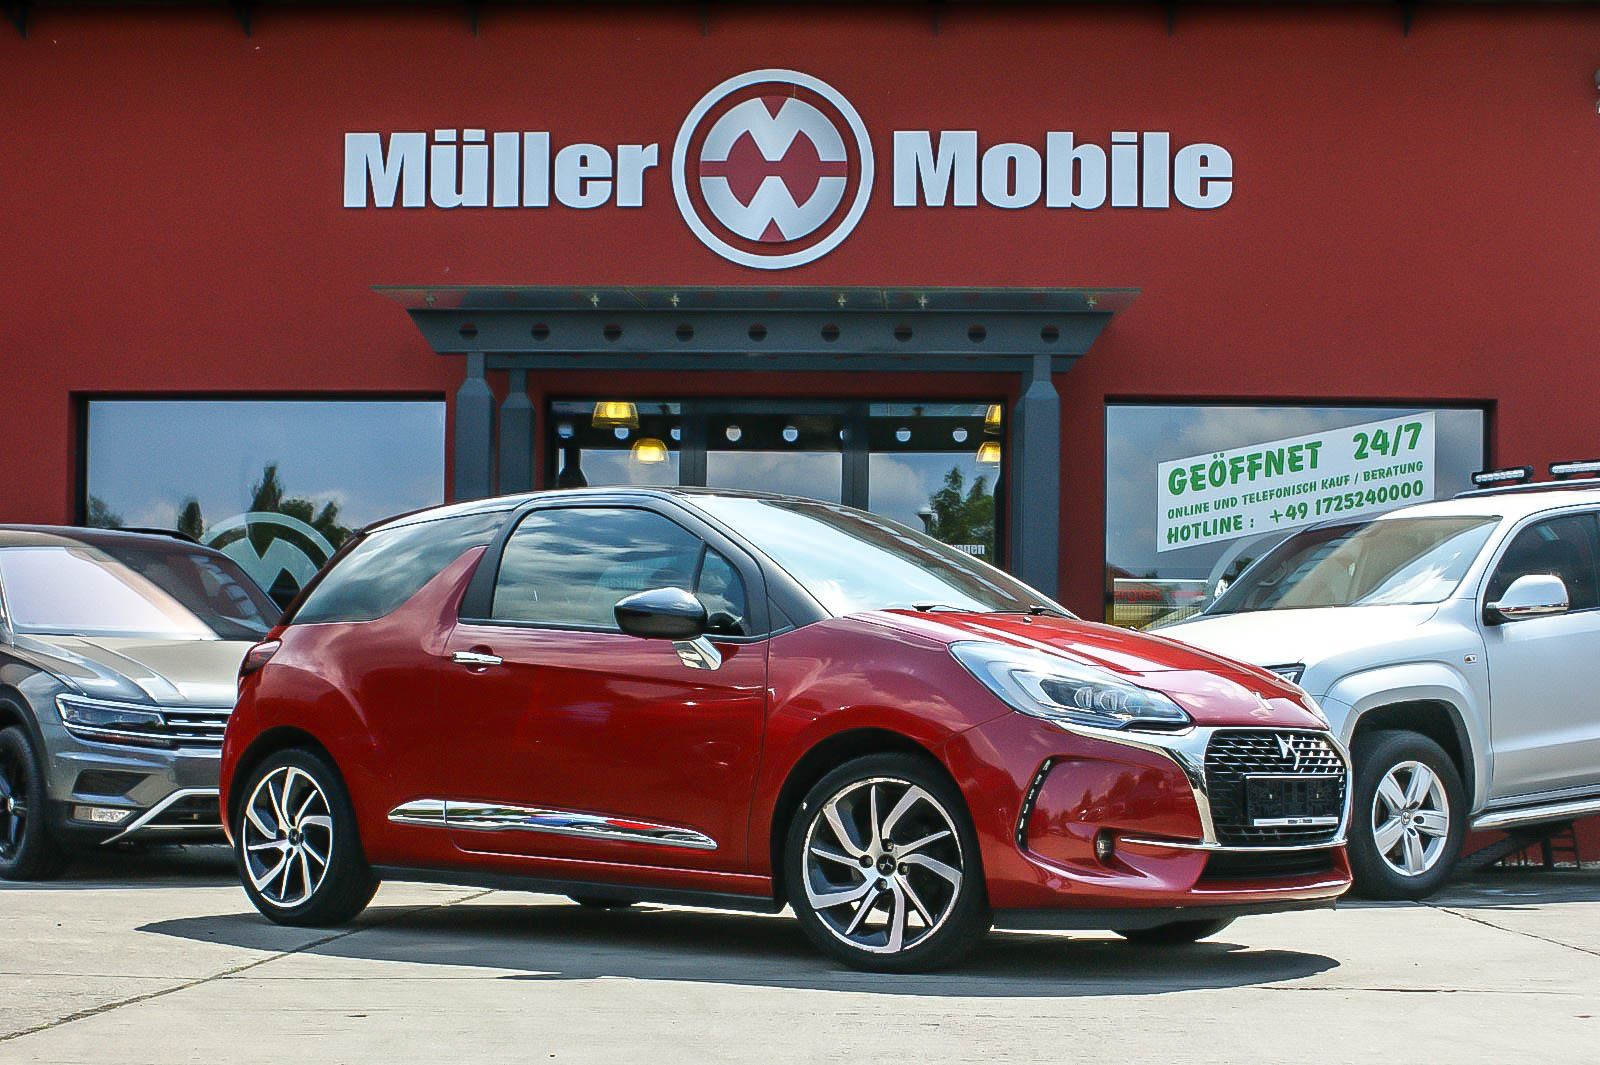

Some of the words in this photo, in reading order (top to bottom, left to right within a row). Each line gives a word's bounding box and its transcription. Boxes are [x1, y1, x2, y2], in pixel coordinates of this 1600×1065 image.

[343, 128, 659, 209] Müller
[893, 130, 1234, 210] Mobile
[1166, 440, 1323, 497] GEÖFFNET
[1351, 420, 1424, 462] 24/7
[1167, 502, 1210, 519] ONLINE
[1213, 497, 1238, 510] UND
[1242, 481, 1317, 506] TELEFONISCH
[1321, 474, 1350, 490] KAUF
[1363, 460, 1424, 482] BERATUNG
[1166, 514, 1243, 544] HOTLINE
[1269, 502, 1309, 524] +49
[1315, 480, 1424, 516] 1725240000
